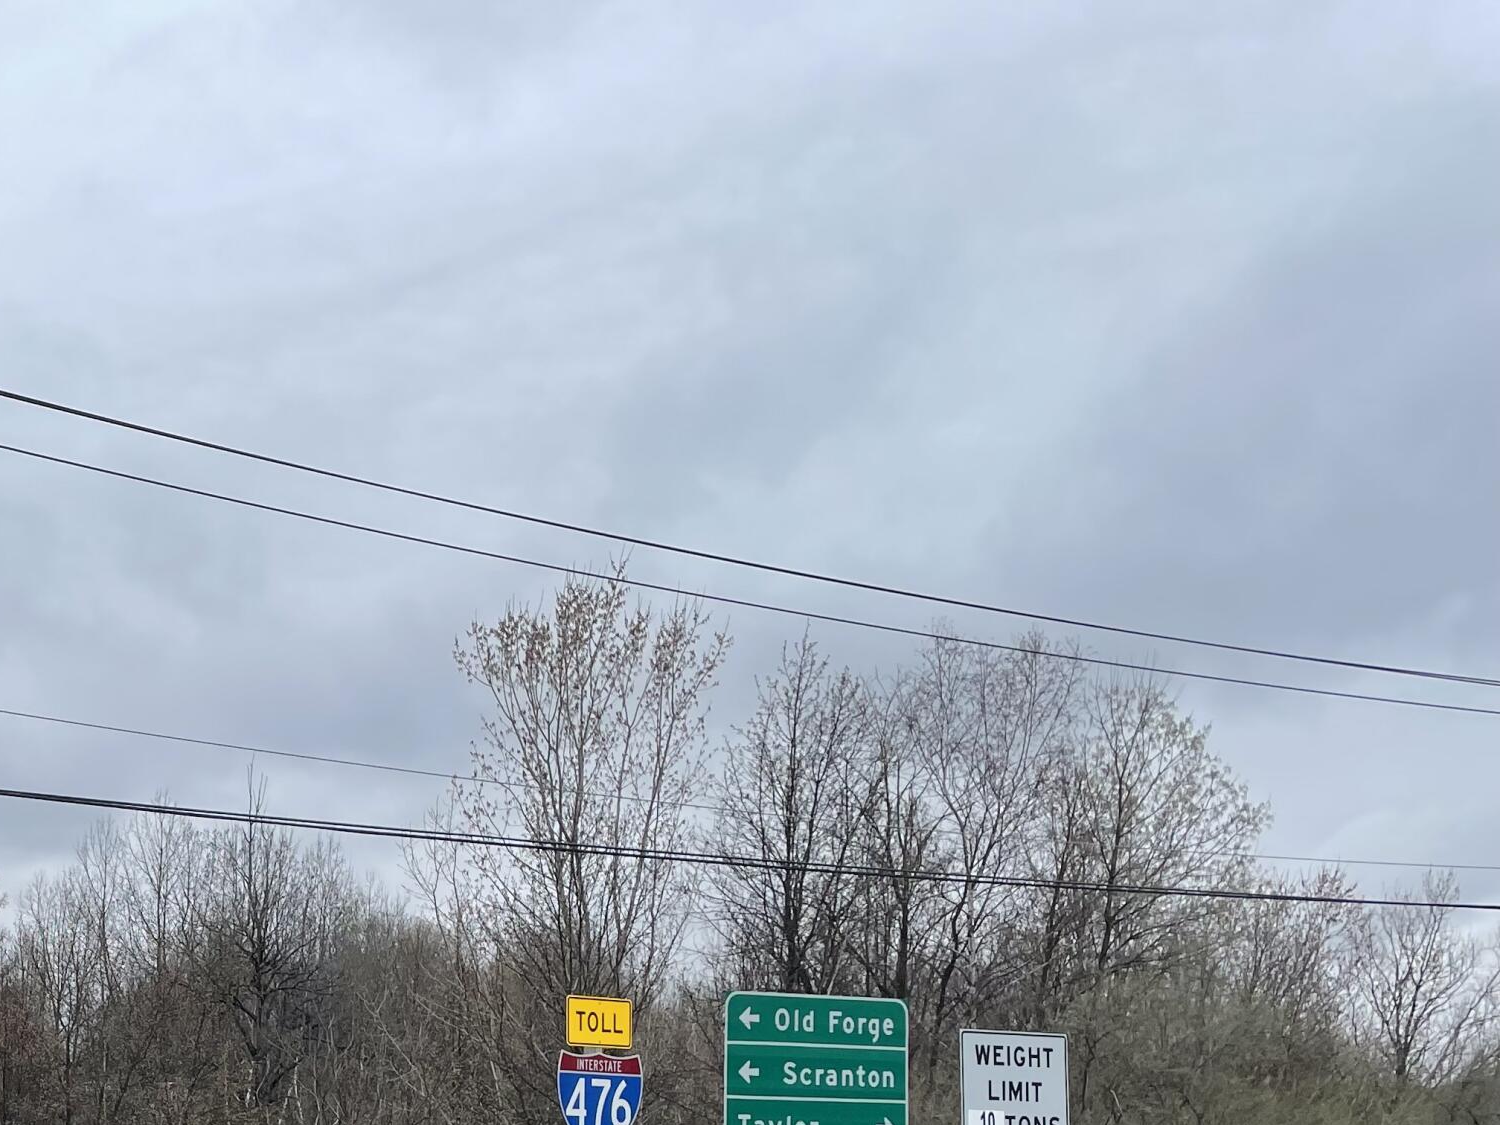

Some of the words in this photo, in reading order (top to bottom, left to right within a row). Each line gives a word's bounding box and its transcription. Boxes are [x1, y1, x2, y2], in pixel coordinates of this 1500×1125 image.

[576, 1011, 623, 1034] TOLL
[775, 1008, 814, 1033] Old
[829, 1011, 894, 1043] Forge
[577, 1059, 622, 1073] INTERSTATE
[975, 1044, 1053, 1068] WEIGHT
[783, 1062, 894, 1088] Scranton
[989, 1080, 1042, 1102] LIMIT
